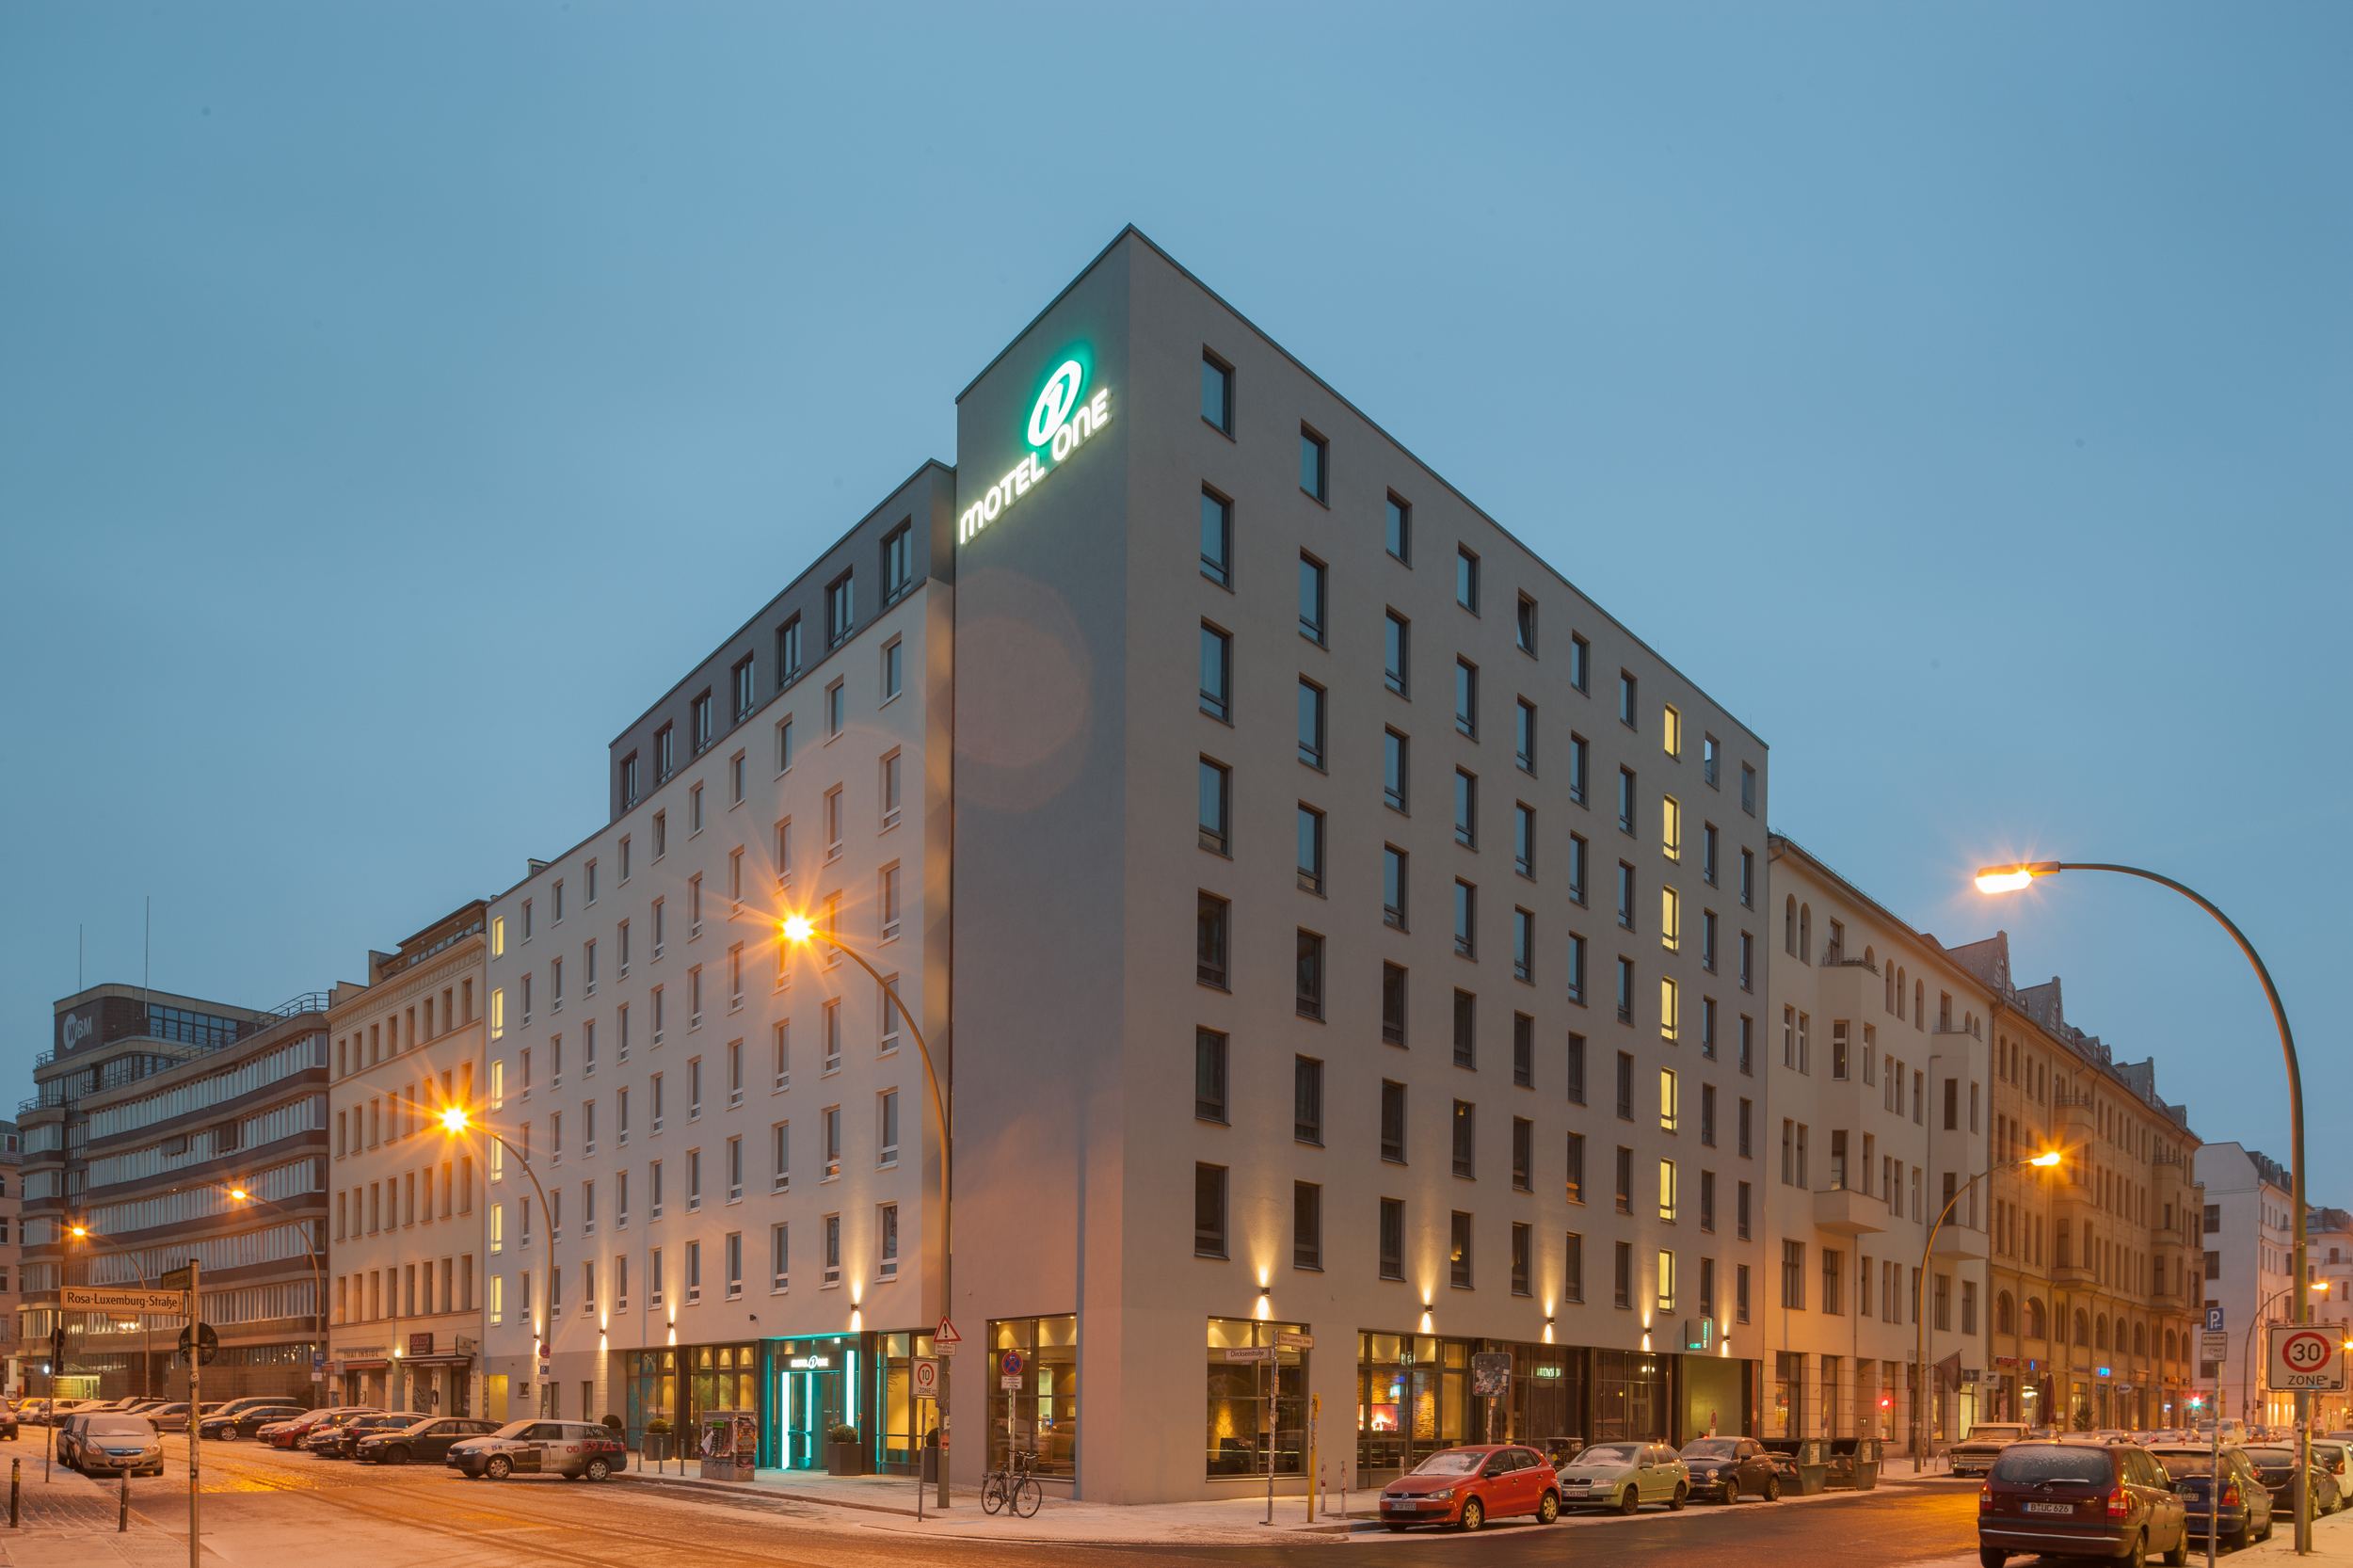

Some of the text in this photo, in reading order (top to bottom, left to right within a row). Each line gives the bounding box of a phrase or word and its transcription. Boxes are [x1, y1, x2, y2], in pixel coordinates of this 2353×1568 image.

[959, 388, 1108, 544] MOTEL ONE
[68, 1016, 92, 1041] WBM
[67, 1291, 178, 1310] Rosa-Luxemburg-Straße
[2293, 1342, 2321, 1362] 30
[921, 1369, 931, 1381] 10
[2288, 1375, 2327, 1385] ZONE
